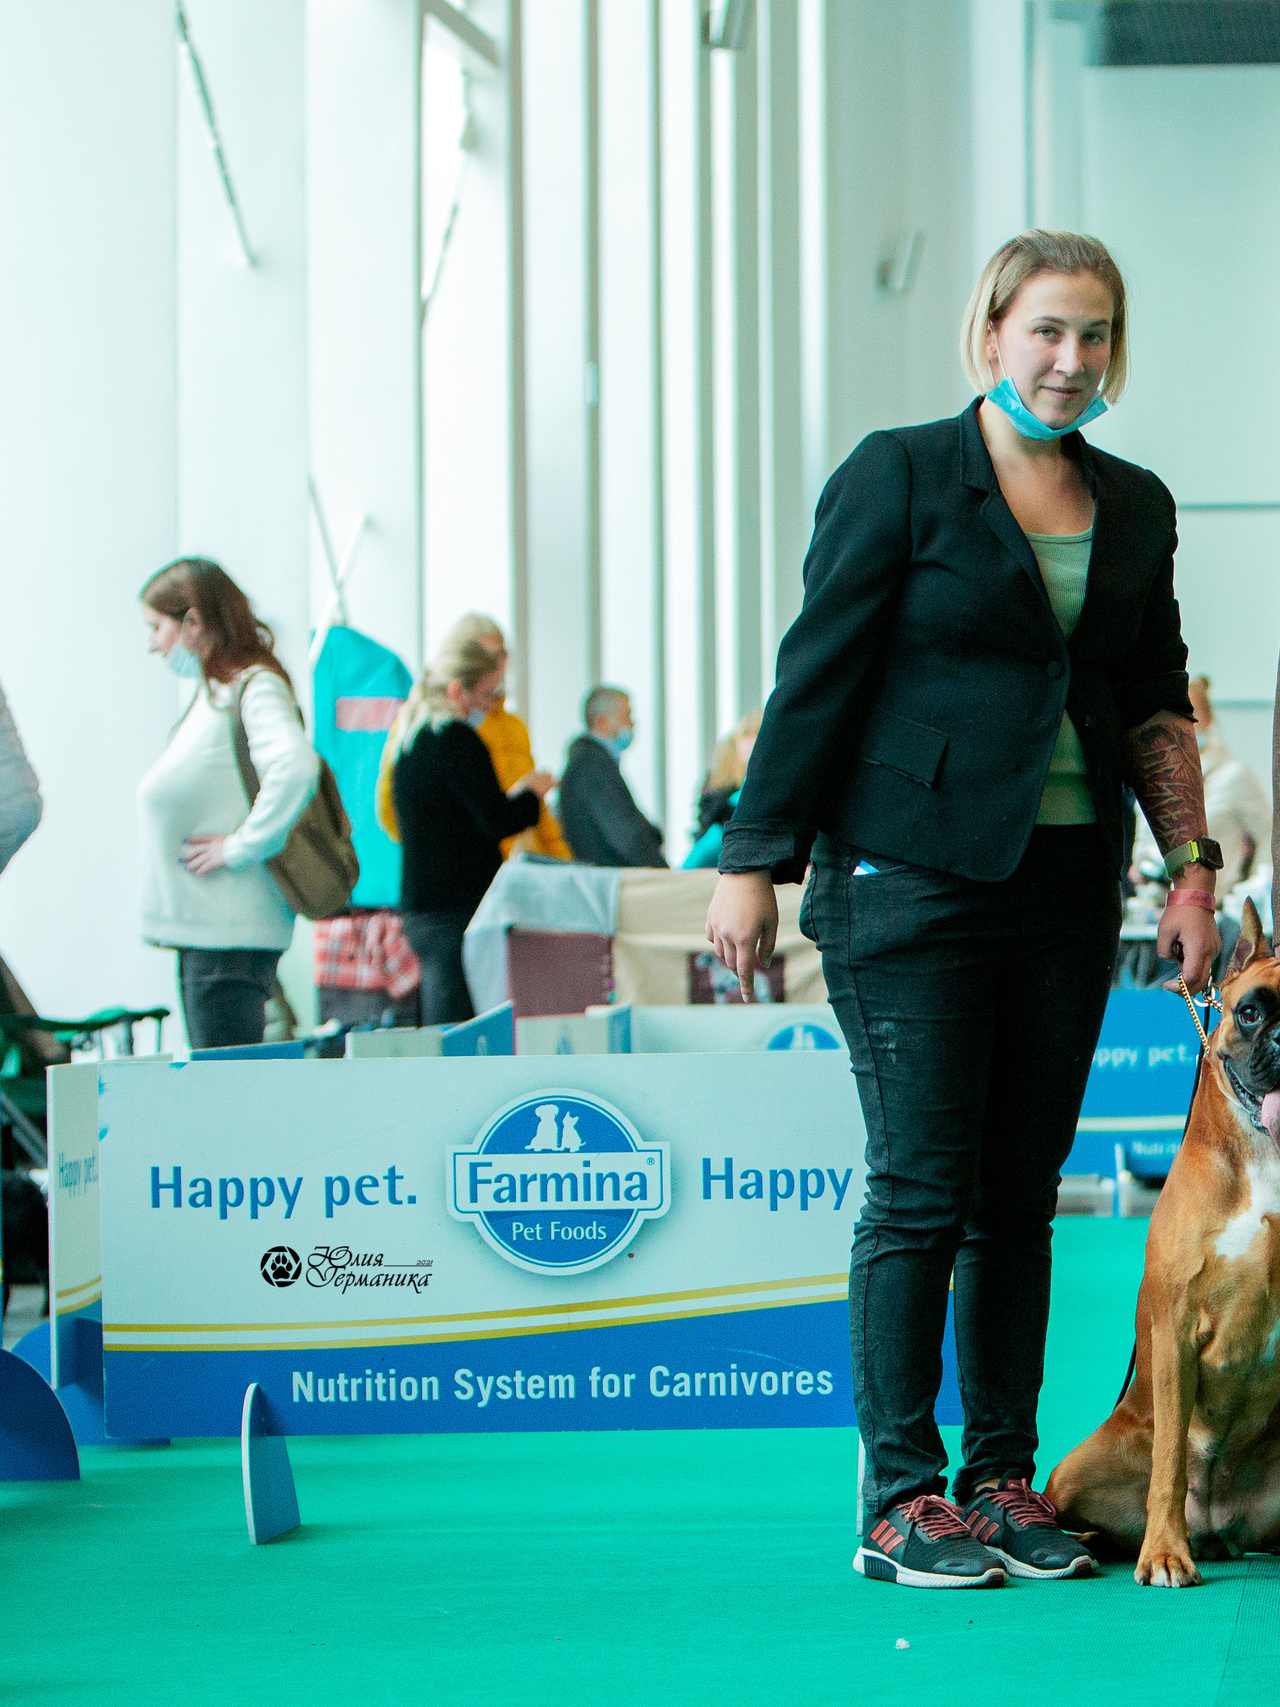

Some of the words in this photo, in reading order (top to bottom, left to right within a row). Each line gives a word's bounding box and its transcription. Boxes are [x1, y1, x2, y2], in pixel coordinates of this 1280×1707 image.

[1096, 1048, 1138, 1068] ppy
[151, 1166, 303, 1220] Happy
[324, 1165, 417, 1218] pet.
[702, 1157, 853, 1212] Happy
[512, 1222, 543, 1241] Pet
[550, 1221, 607, 1241] Foods
[291, 1369, 439, 1403] Nutrition
[453, 1368, 576, 1408] System
[589, 1366, 636, 1399] for
[649, 1363, 834, 1398] Carnivores
